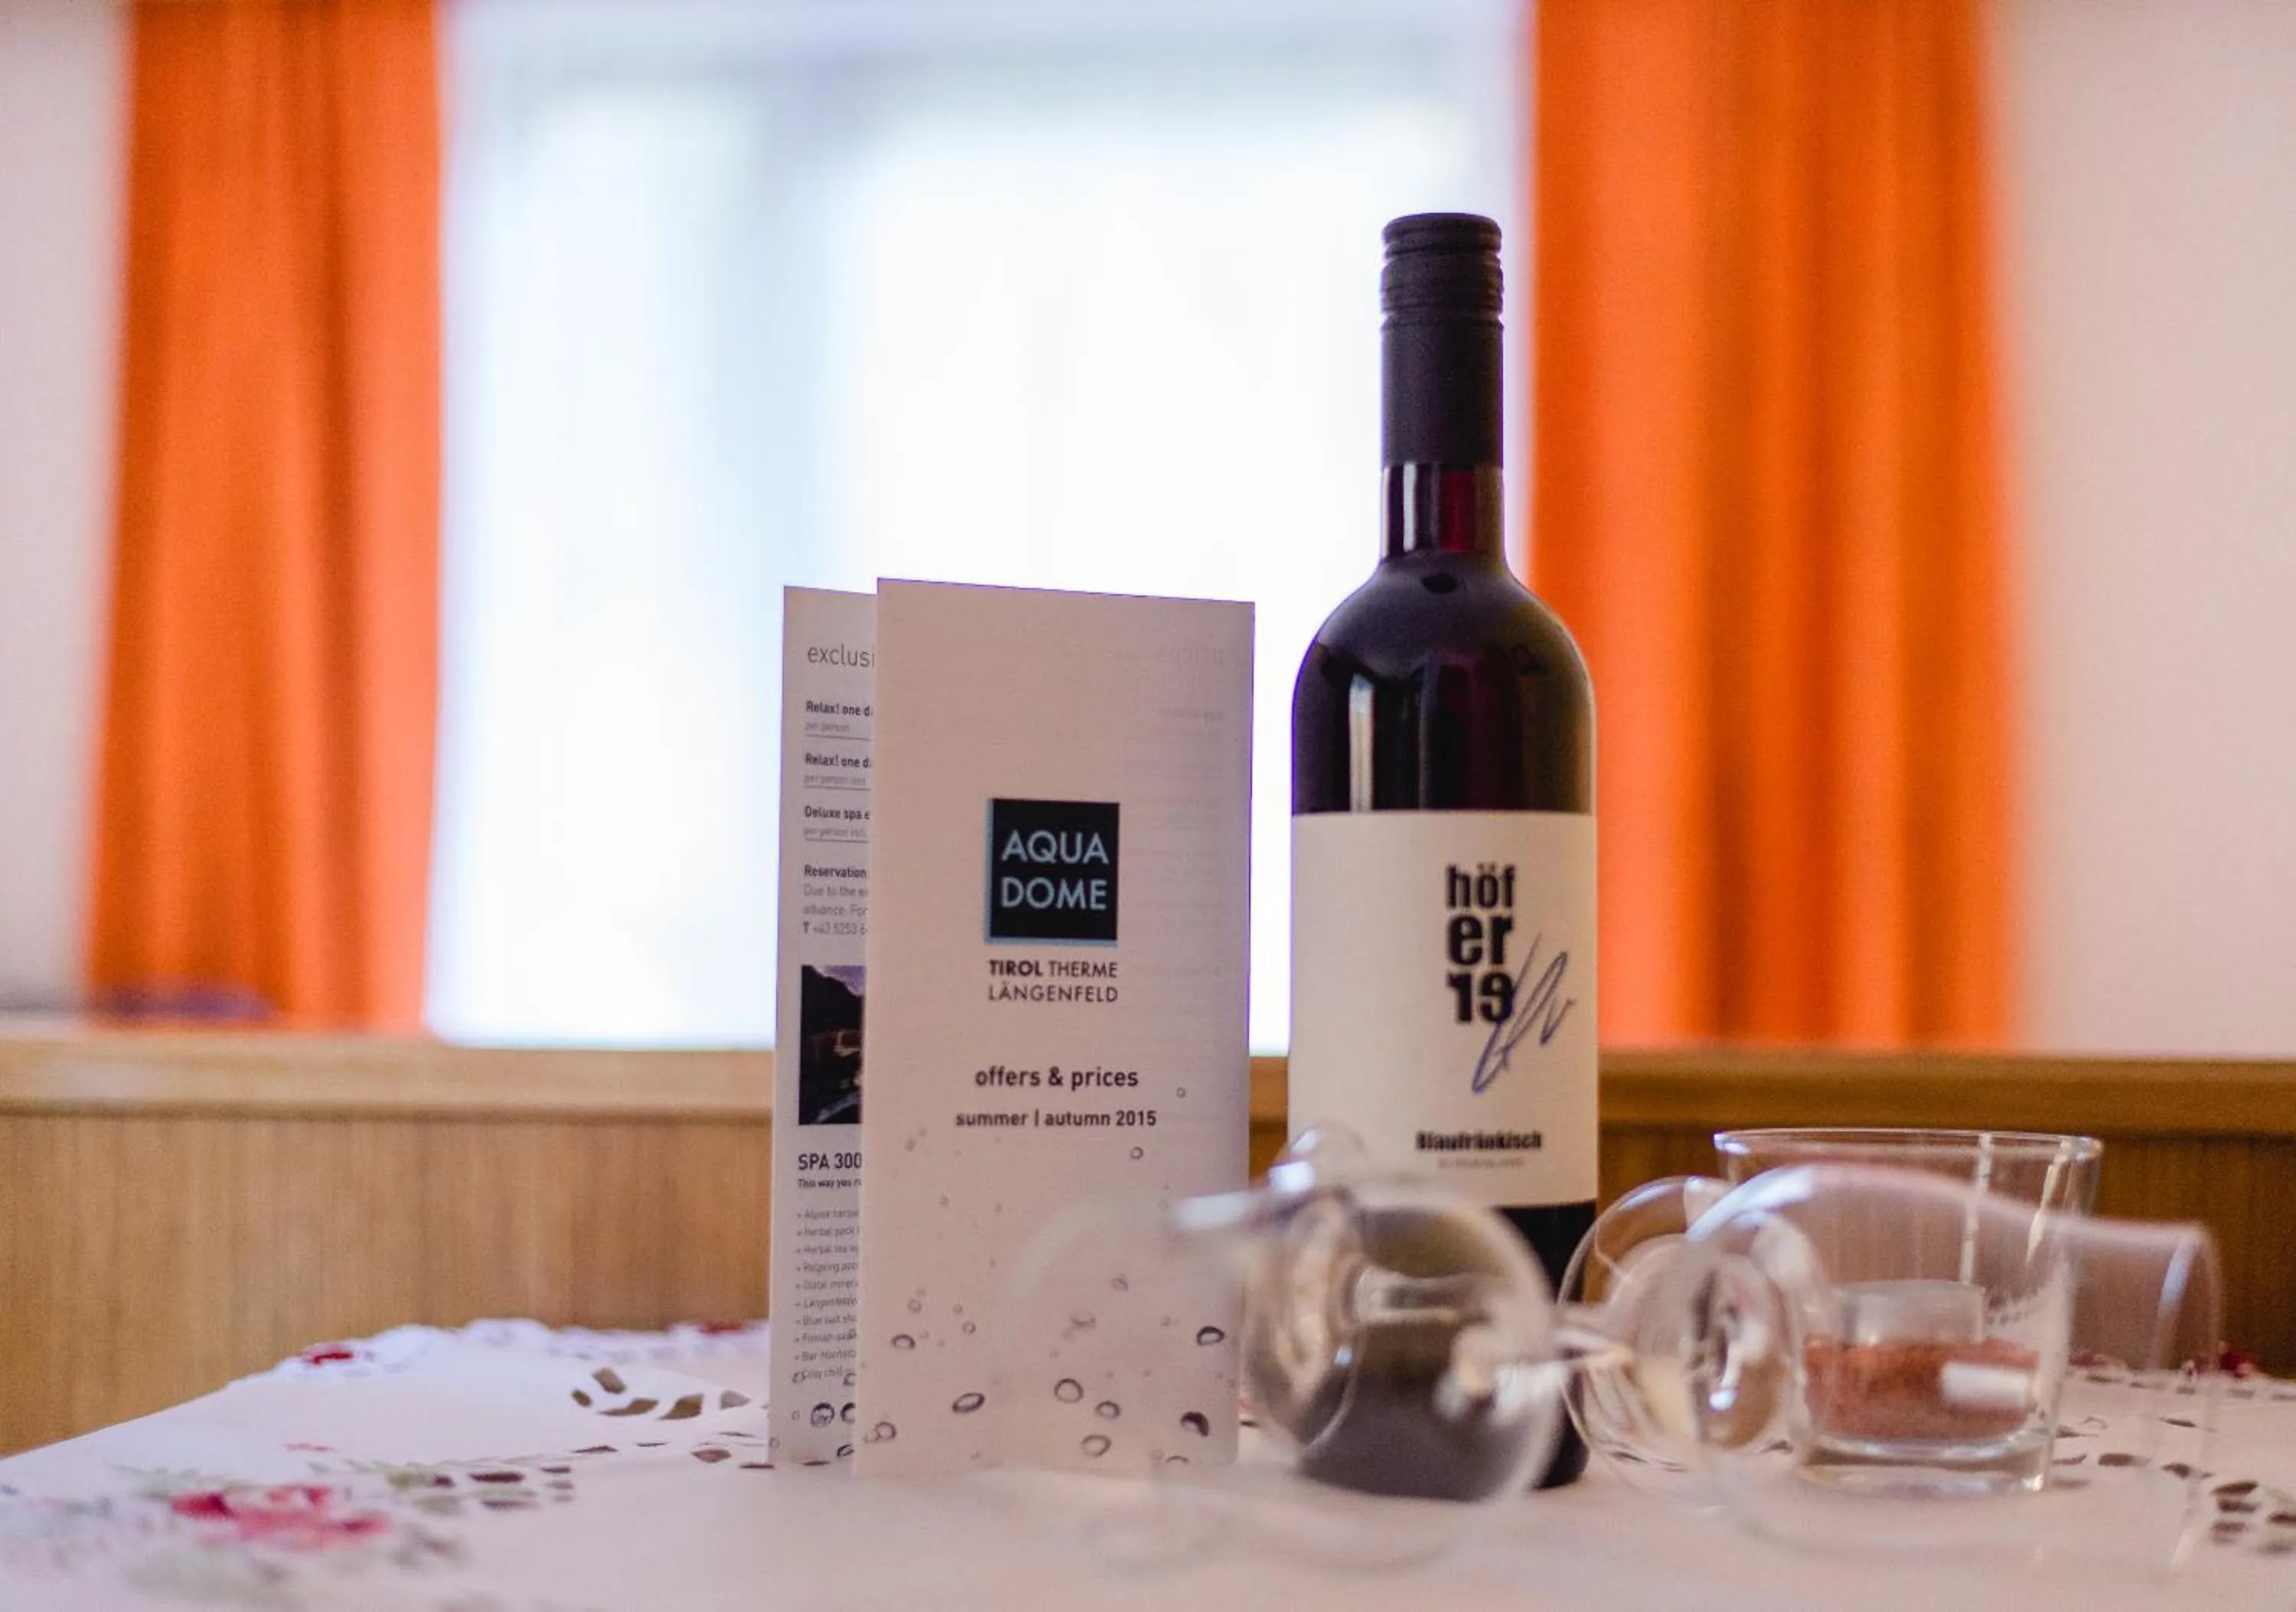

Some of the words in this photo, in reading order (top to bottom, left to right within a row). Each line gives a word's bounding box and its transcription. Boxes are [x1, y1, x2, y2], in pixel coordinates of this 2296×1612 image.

[806, 700, 840, 715] Relax!
[843, 705, 861, 715] one
[805, 752, 839, 766] Relax!
[841, 758, 860, 767] one
[805, 805, 840, 818] Deluxe
[843, 809, 863, 821] spa
[1001, 830, 1110, 864] AQUA
[804, 883, 824, 896] Due
[827, 886, 837, 896] to
[840, 886, 856, 896] the
[1001, 876, 1108, 909] DOME
[1446, 863, 1515, 909] höf
[803, 921, 810, 934] T
[1449, 915, 1513, 966] er
[989, 960, 1043, 977] TIROL
[1049, 961, 1118, 978] THERME
[987, 981, 1119, 1003] LÄNGENFELD
[975, 1065, 1041, 1087] offers
[1048, 1066, 1064, 1087] &
[1071, 1066, 1140, 1092] prices
[956, 1111, 1029, 1127] summer
[1045, 1112, 1110, 1127] autumn
[1116, 1110, 1157, 1127] 2015
[798, 1153, 830, 1170] SPA
[834, 1152, 863, 1170] 300
[798, 1179, 817, 1189] This
[818, 1180, 835, 1189] way
[836, 1180, 852, 1189] you
